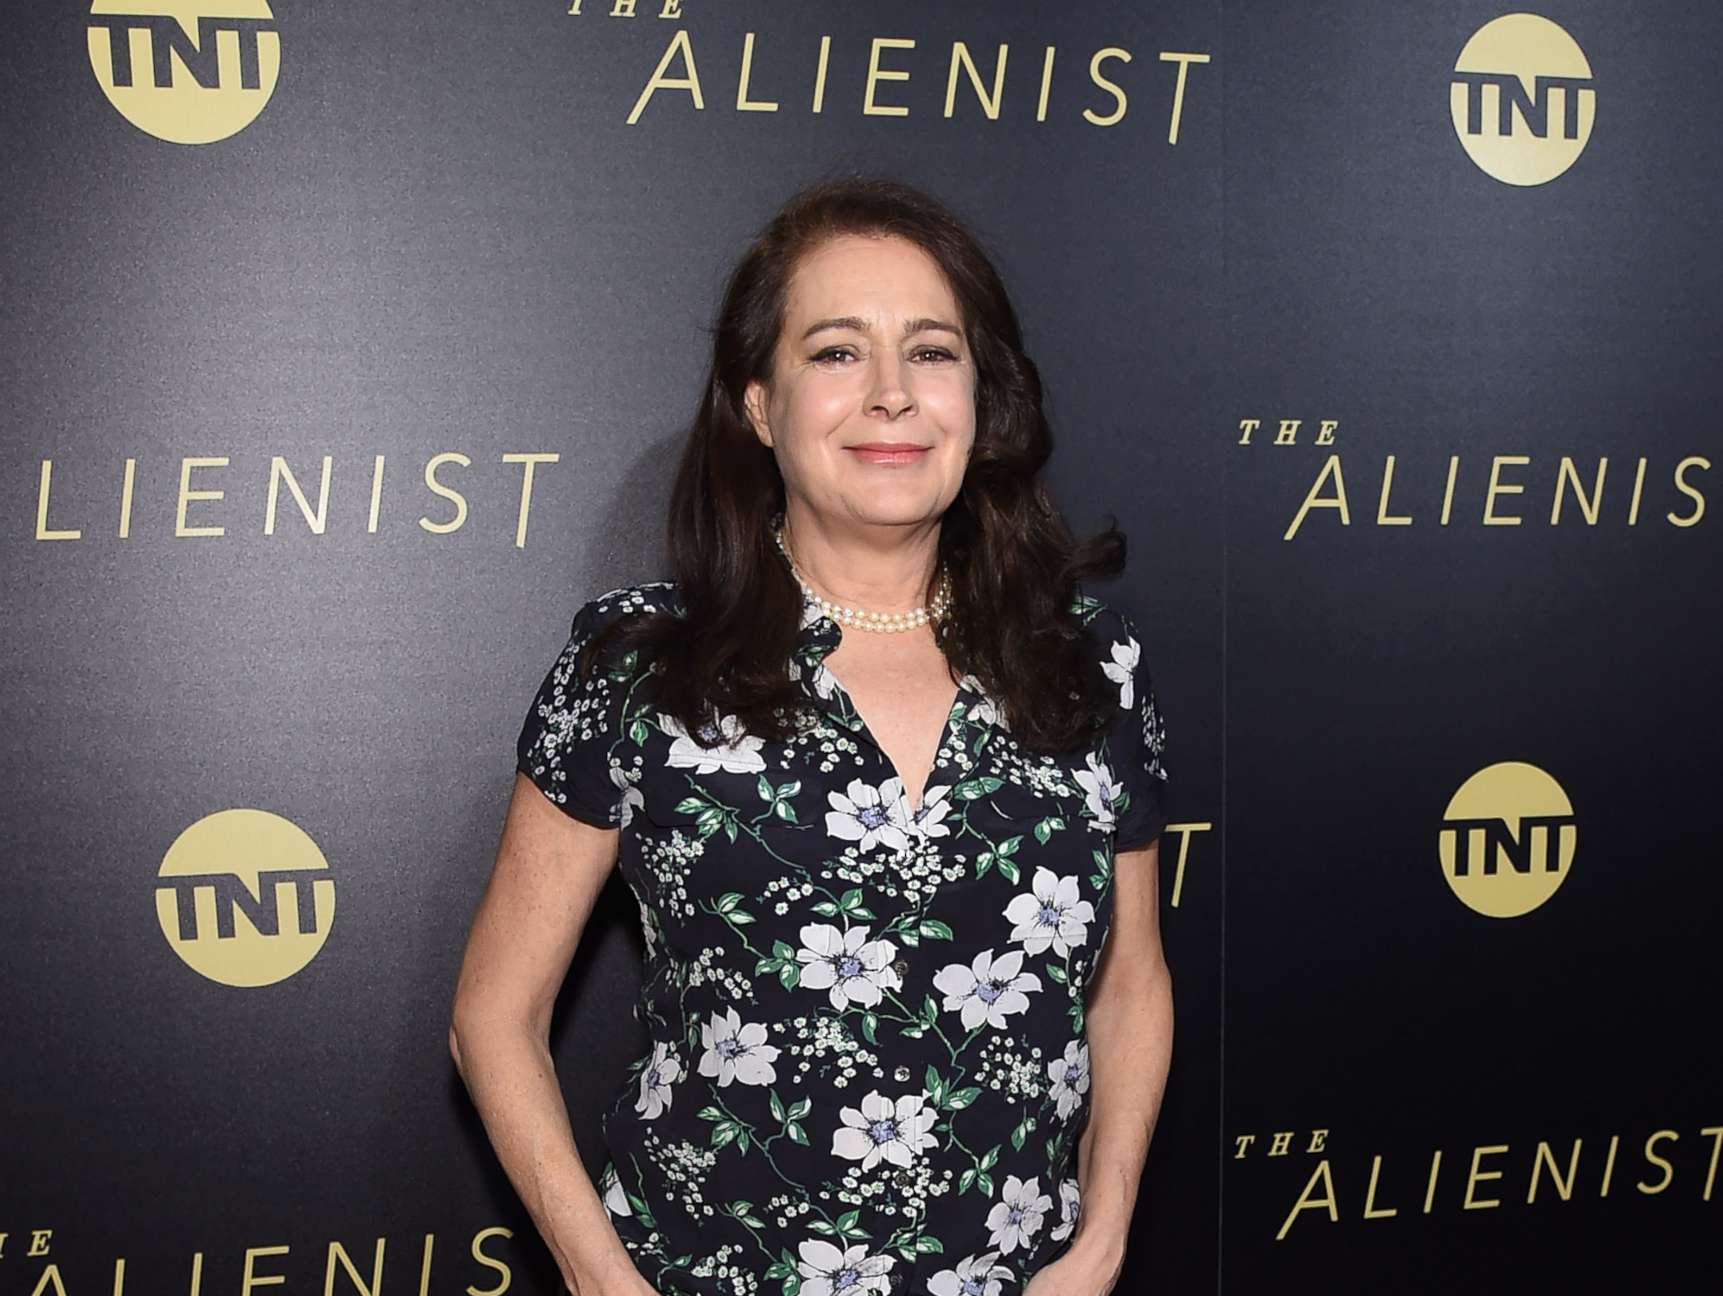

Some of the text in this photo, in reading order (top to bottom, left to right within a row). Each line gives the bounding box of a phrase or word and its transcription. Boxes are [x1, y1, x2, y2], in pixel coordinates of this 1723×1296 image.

[90, 13, 279, 90] TNT
[626, 30, 1211, 143] ALIENIST
[1451, 71, 1596, 140] TNT
[1239, 419, 1337, 446] THE
[36, 452, 559, 547] LIENIST
[1284, 455, 1712, 541] ALIENIS
[1440, 815, 1577, 876] TNT
[155, 868, 336, 941] TNT
[1235, 1129, 1330, 1160] THE
[1277, 1125, 1723, 1241] ALIENIST
